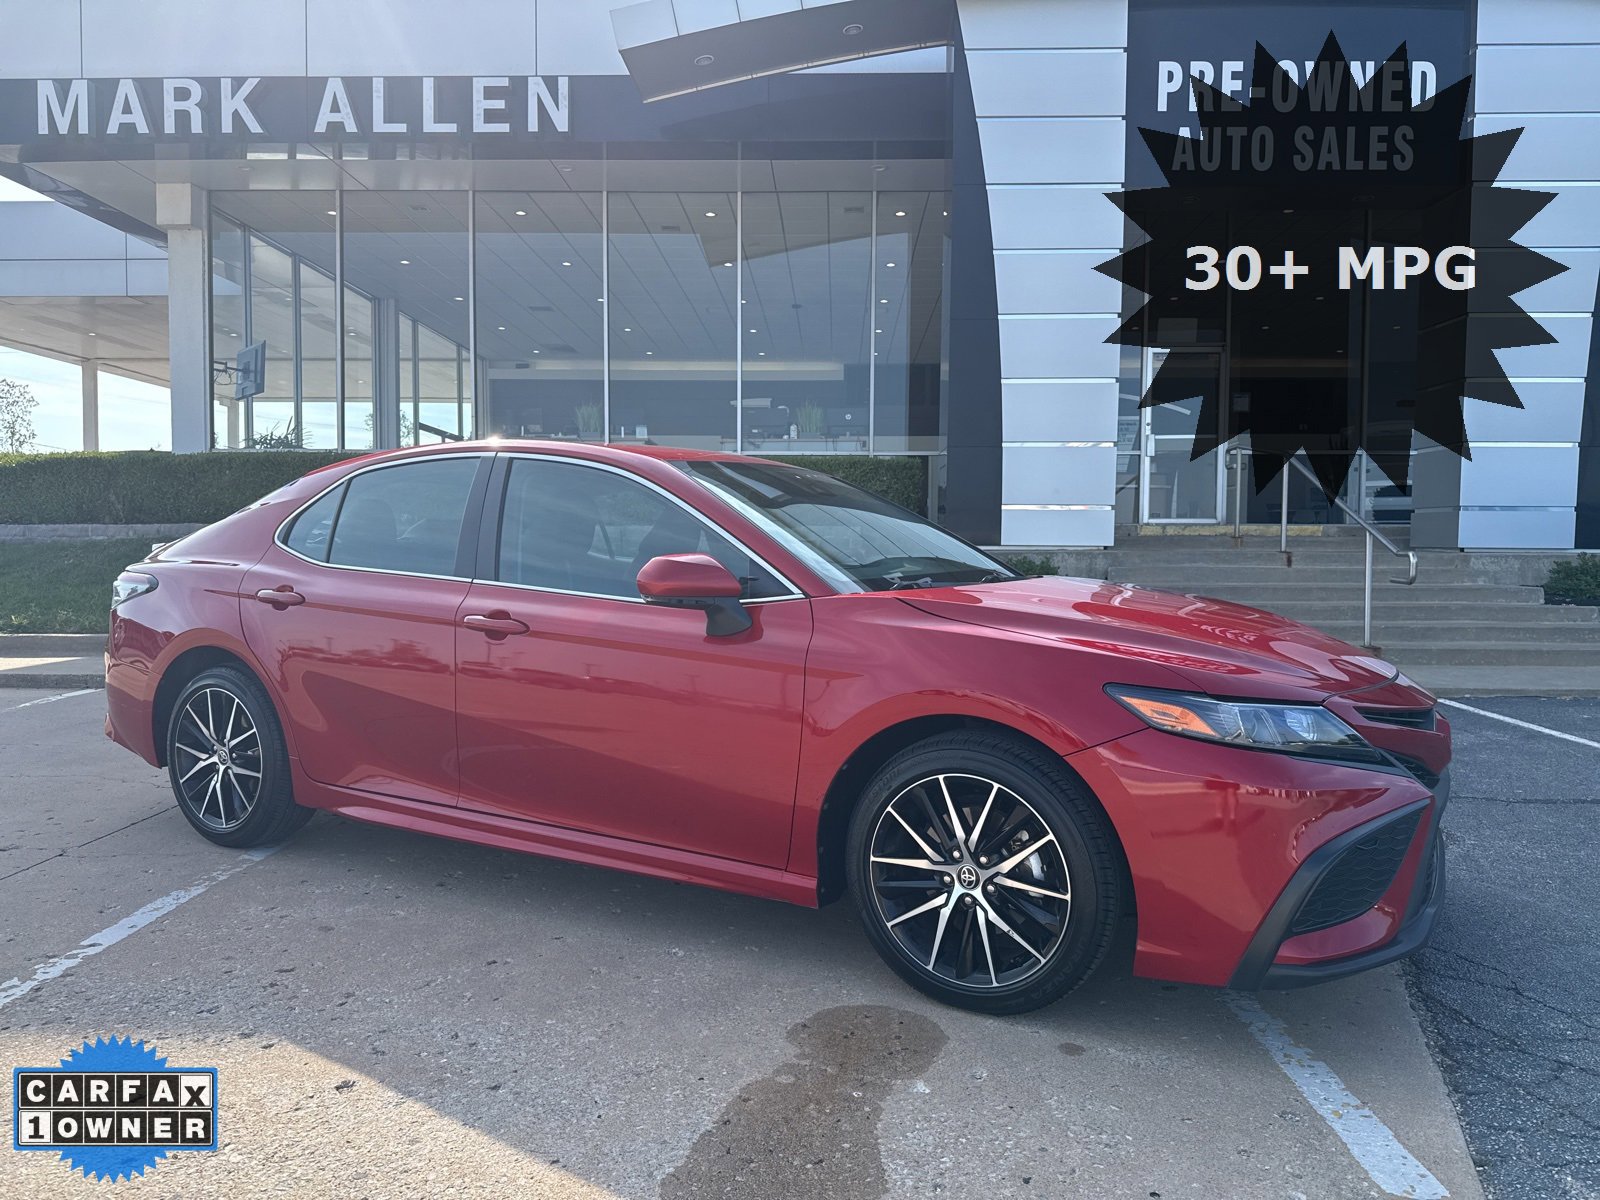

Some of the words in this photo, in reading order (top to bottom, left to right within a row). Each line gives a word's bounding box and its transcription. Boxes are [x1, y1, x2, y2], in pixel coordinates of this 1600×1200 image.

[36, 77, 264, 135] MARK
[313, 76, 570, 133] ALLEN
[1157, 59, 1438, 113] PRE-OWNED
[1171, 125, 1275, 172] AUTO
[1292, 125, 1415, 172] SALES
